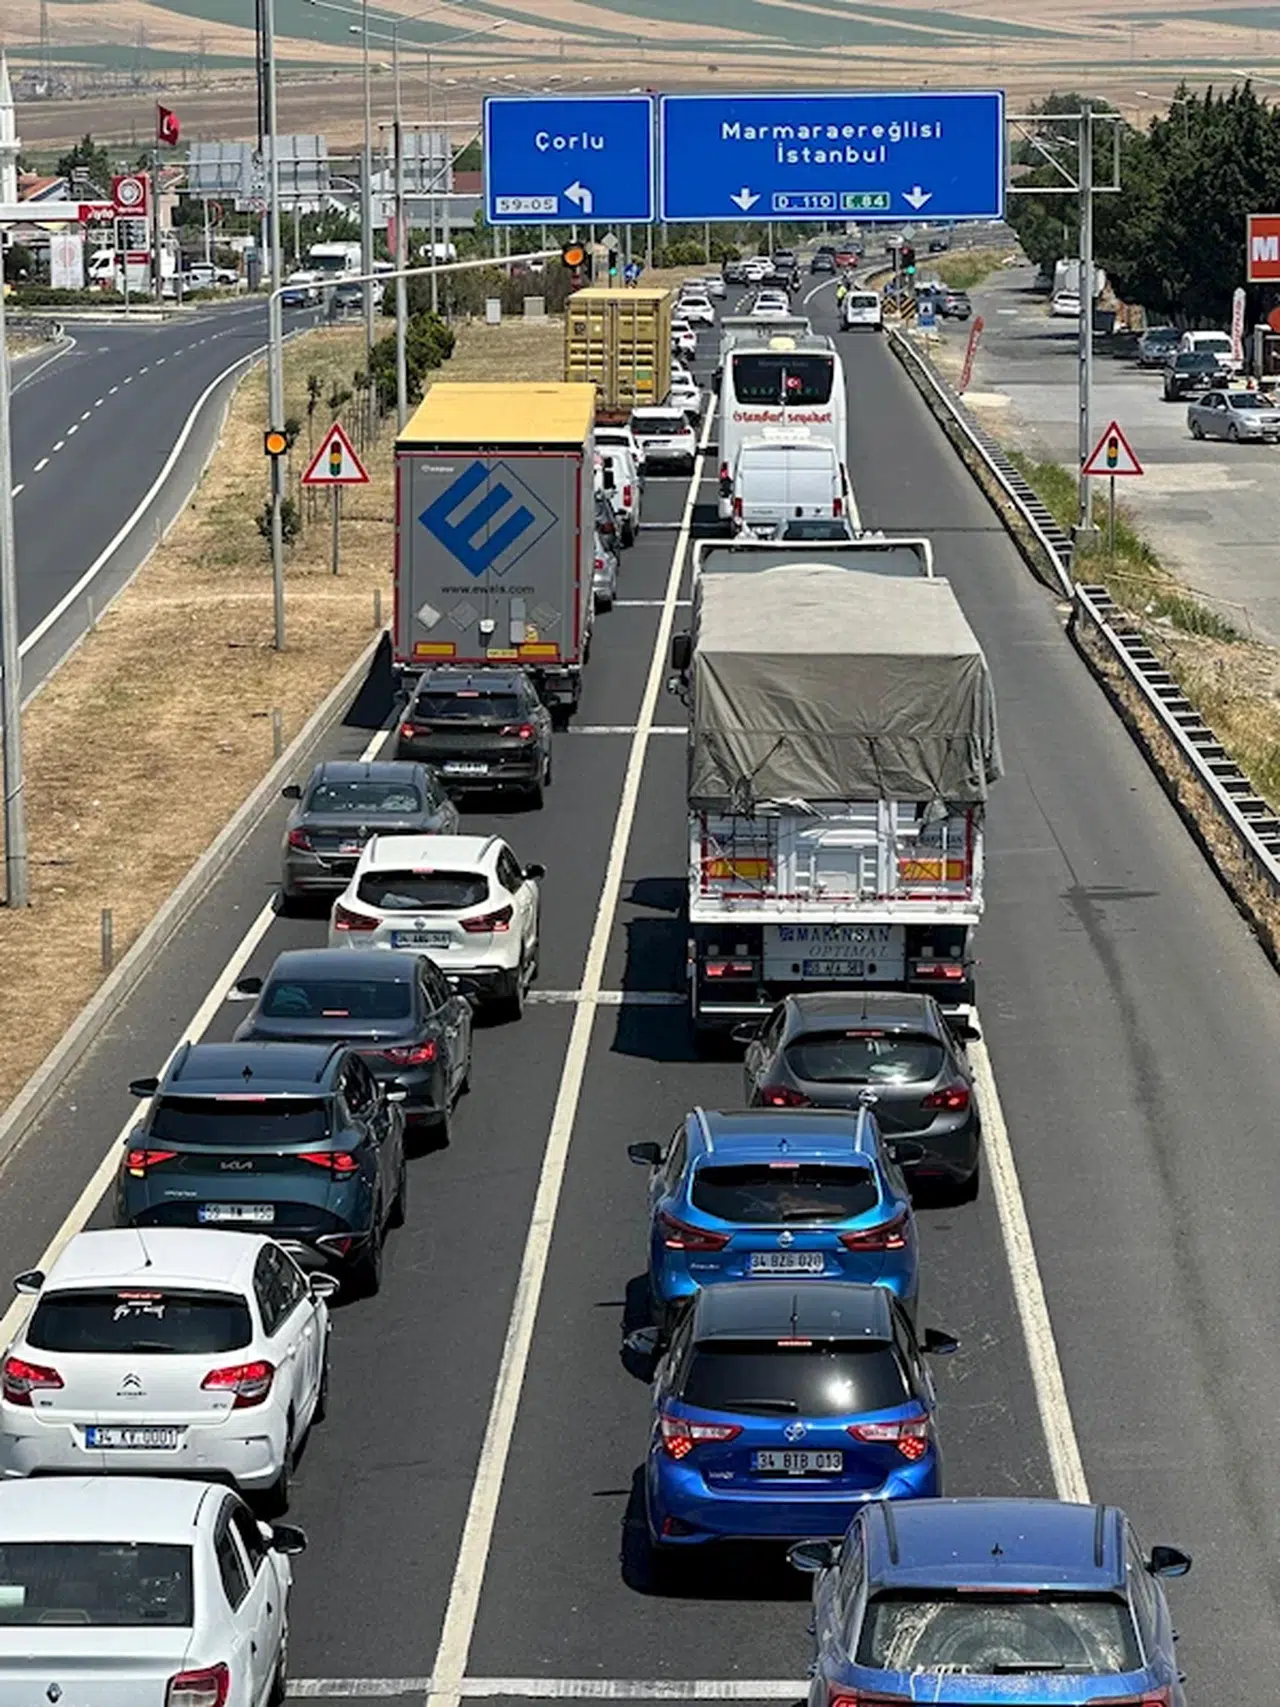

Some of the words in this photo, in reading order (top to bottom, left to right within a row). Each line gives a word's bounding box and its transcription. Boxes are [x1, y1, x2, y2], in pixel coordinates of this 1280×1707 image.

[535, 131, 604, 152] Çorlu
[721, 121, 942, 142] Marmaraereğlisi
[777, 142, 886, 163] İstanbul
[752, 1254, 766, 1267] 34
[759, 1453, 774, 1468] 34
[783, 1453, 809, 1468] BTB
[815, 1453, 841, 1468] 013
